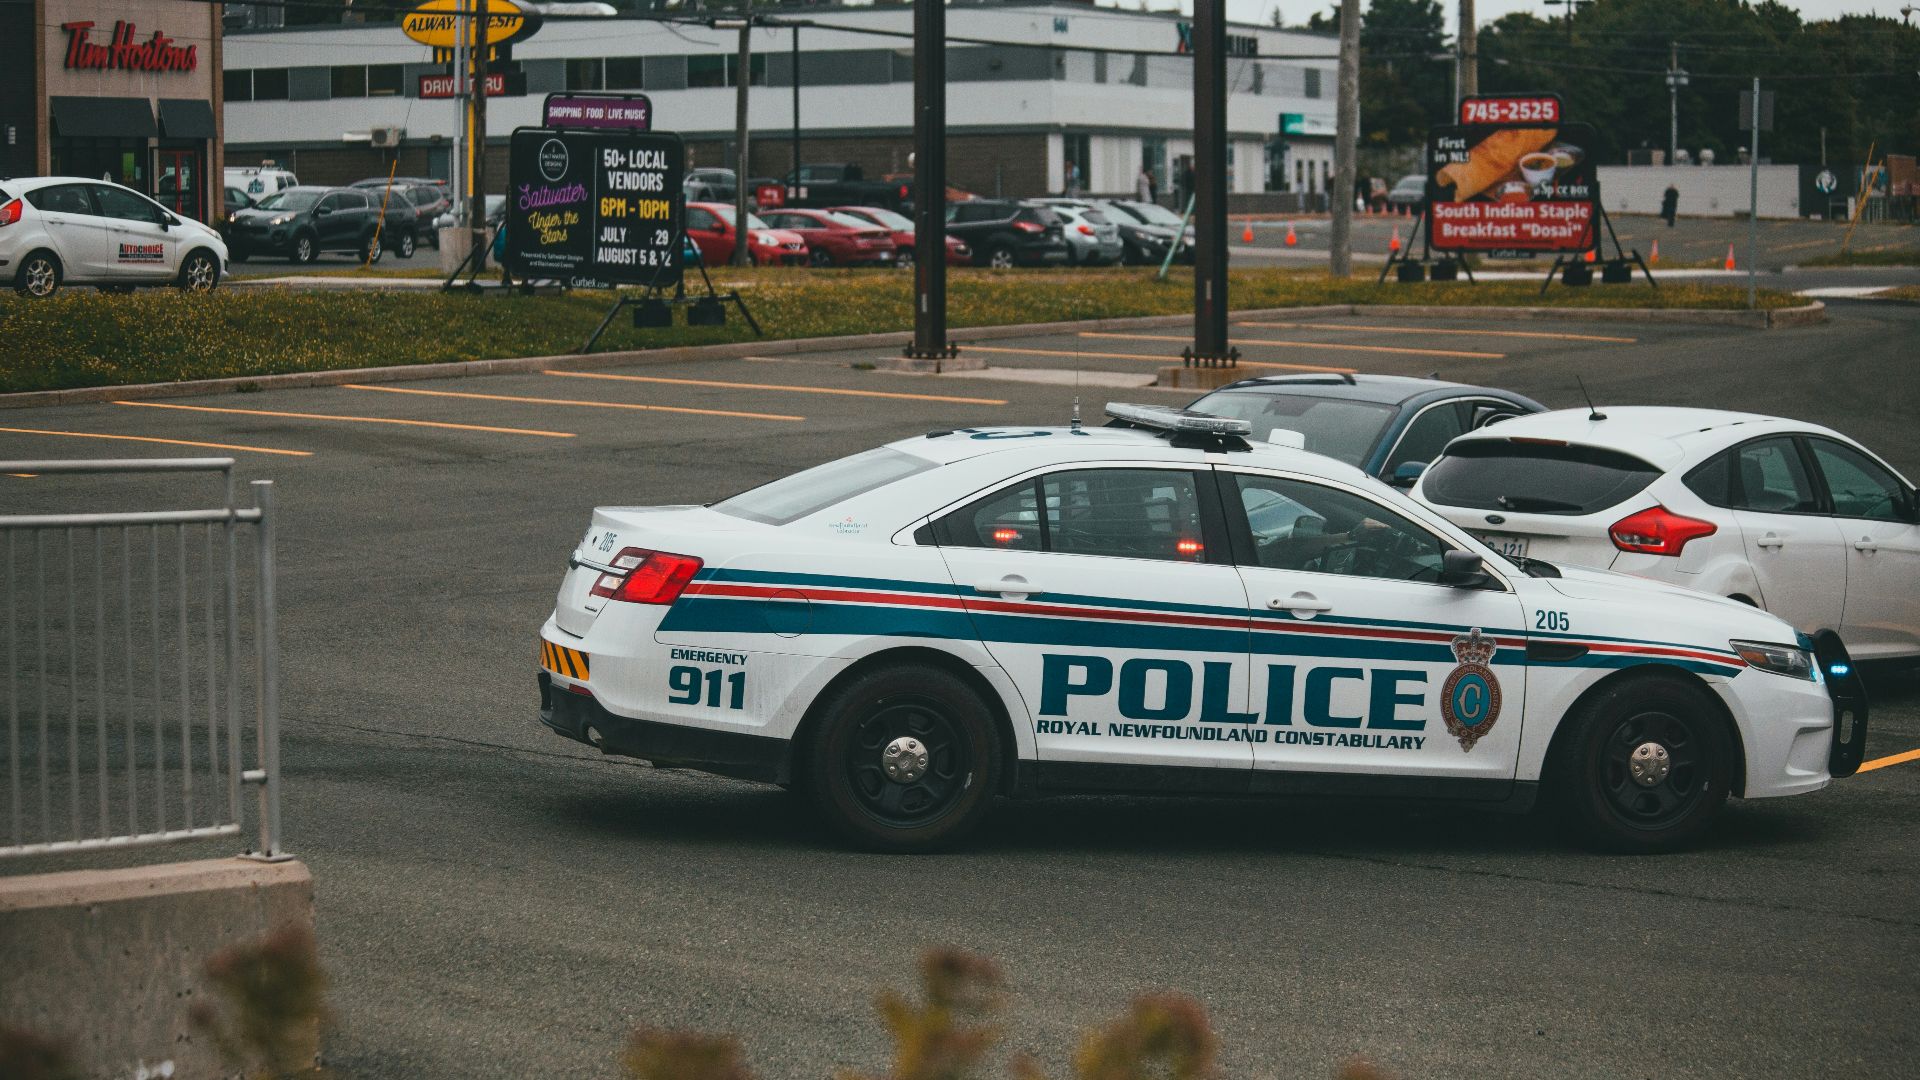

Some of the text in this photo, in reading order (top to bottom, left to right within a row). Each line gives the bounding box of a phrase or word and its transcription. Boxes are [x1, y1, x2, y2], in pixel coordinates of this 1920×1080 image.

[407, 15, 456, 32] ALWAY
[61, 20, 197, 71] Tim Hortons
[423, 78, 455, 94] DRIV
[549, 106, 646, 120] SHOPPING FOOD LIVE MUSIC
[1467, 102, 1554, 121] 745-2525
[1438, 137, 1465, 149] First
[604, 148, 668, 169] 50+ LOCAL
[1434, 150, 1447, 162] in
[608, 171, 663, 192] VENDORS
[519, 182, 588, 210] Saltwater
[601, 198, 626, 218] 6PM
[639, 199, 669, 220] 10PM
[1435, 203, 1589, 222] South Indian Staple
[528, 210, 579, 230] Under the
[1443, 221, 1582, 237] Breakfast "Dosai"
[541, 228, 568, 245] Stars
[600, 227, 669, 246] JULY 29
[598, 247, 637, 264] AUGUST
[640, 250, 647, 265] 5
[649, 250, 658, 266] &
[599, 532, 618, 552] 205
[1535, 609, 1570, 632] 205
[671, 648, 748, 666] EMERGENCY
[668, 666, 746, 710] 911
[1039, 653, 1428, 731] POLICE
[1458, 683, 1481, 718] C
[1037, 719, 1426, 750] ROYAL NEWFOUNDLAND CONSTABULARY
